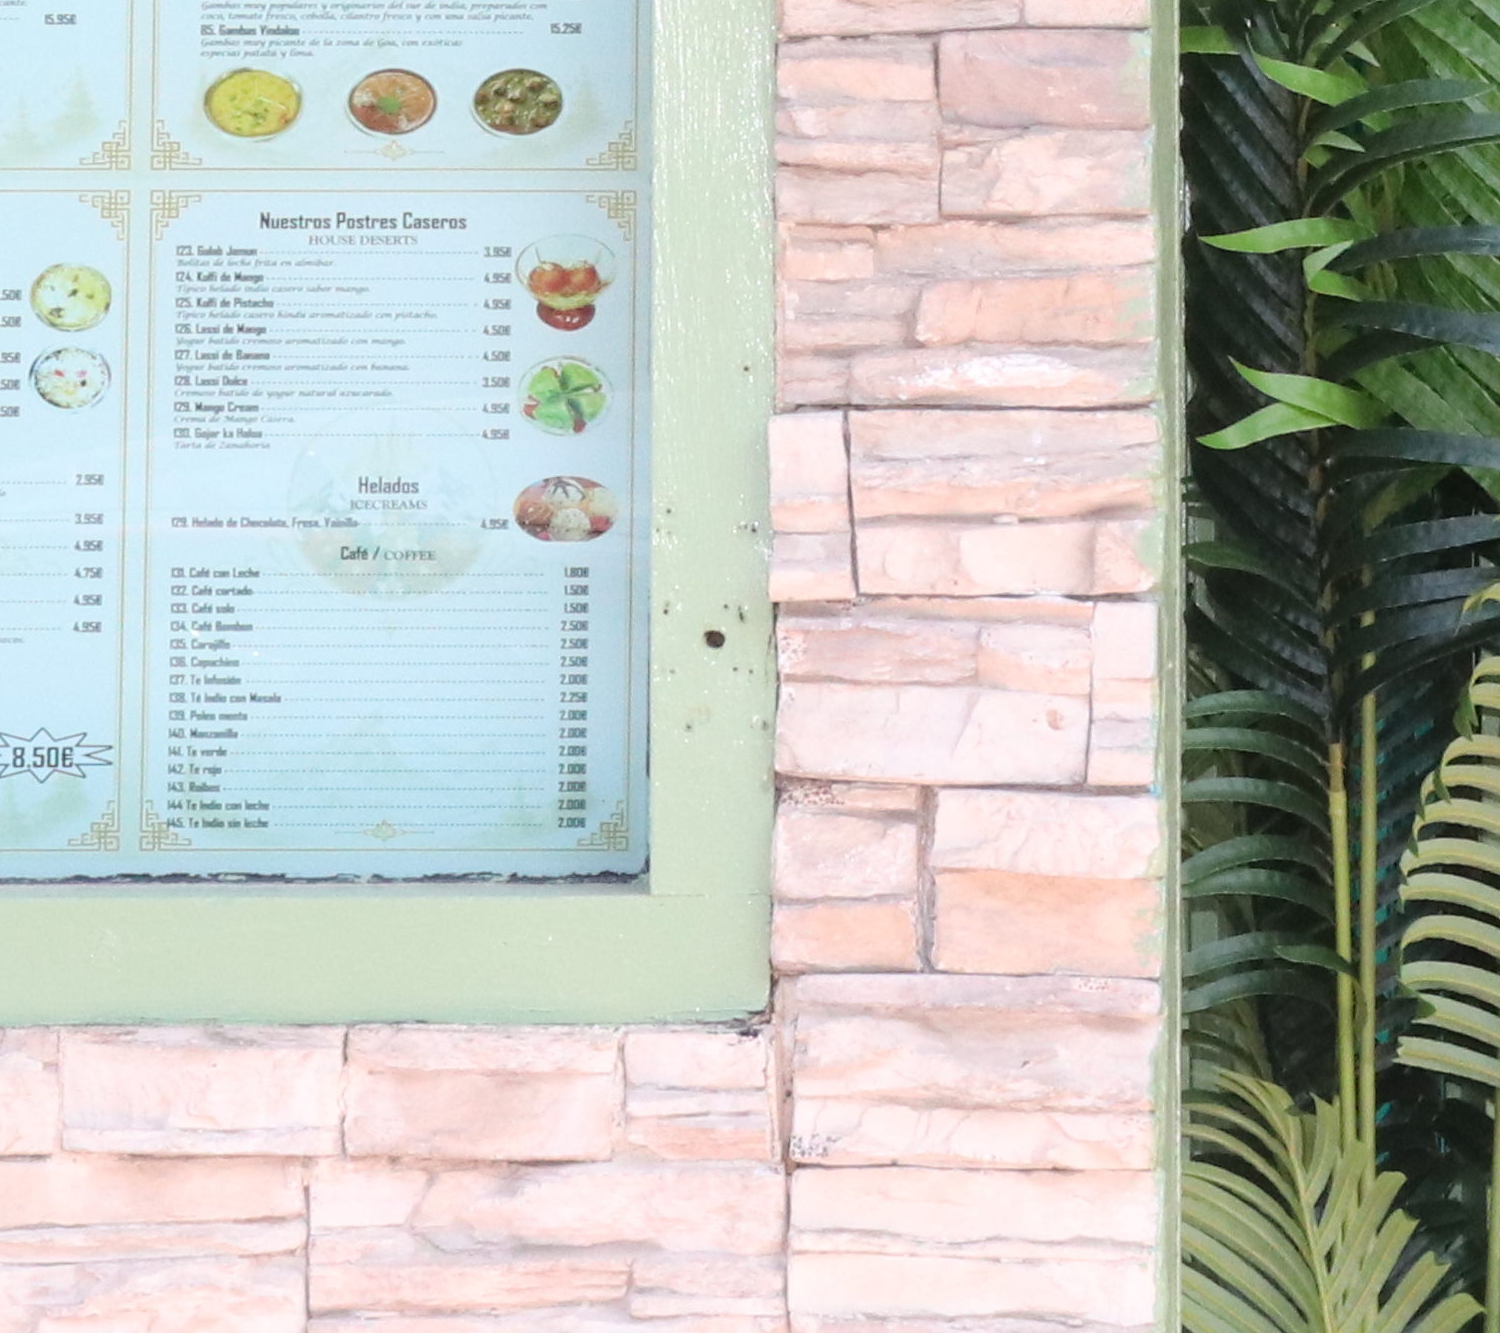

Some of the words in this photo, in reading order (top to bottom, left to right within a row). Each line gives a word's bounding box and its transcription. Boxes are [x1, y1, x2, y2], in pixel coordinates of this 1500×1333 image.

[260, 212, 331, 229] Nuestros
[336, 212, 397, 229] Postres
[403, 212, 466, 229] Caseros
[309, 235, 356, 245] HOUSE
[360, 235, 418, 245] DESERTS
[359, 476, 419, 494] Helados
[340, 546, 368, 560] Café
[372, 546, 378, 560] /
[383, 551, 437, 561] COFFEE
[12, 747, 74, 768] 8.50€
